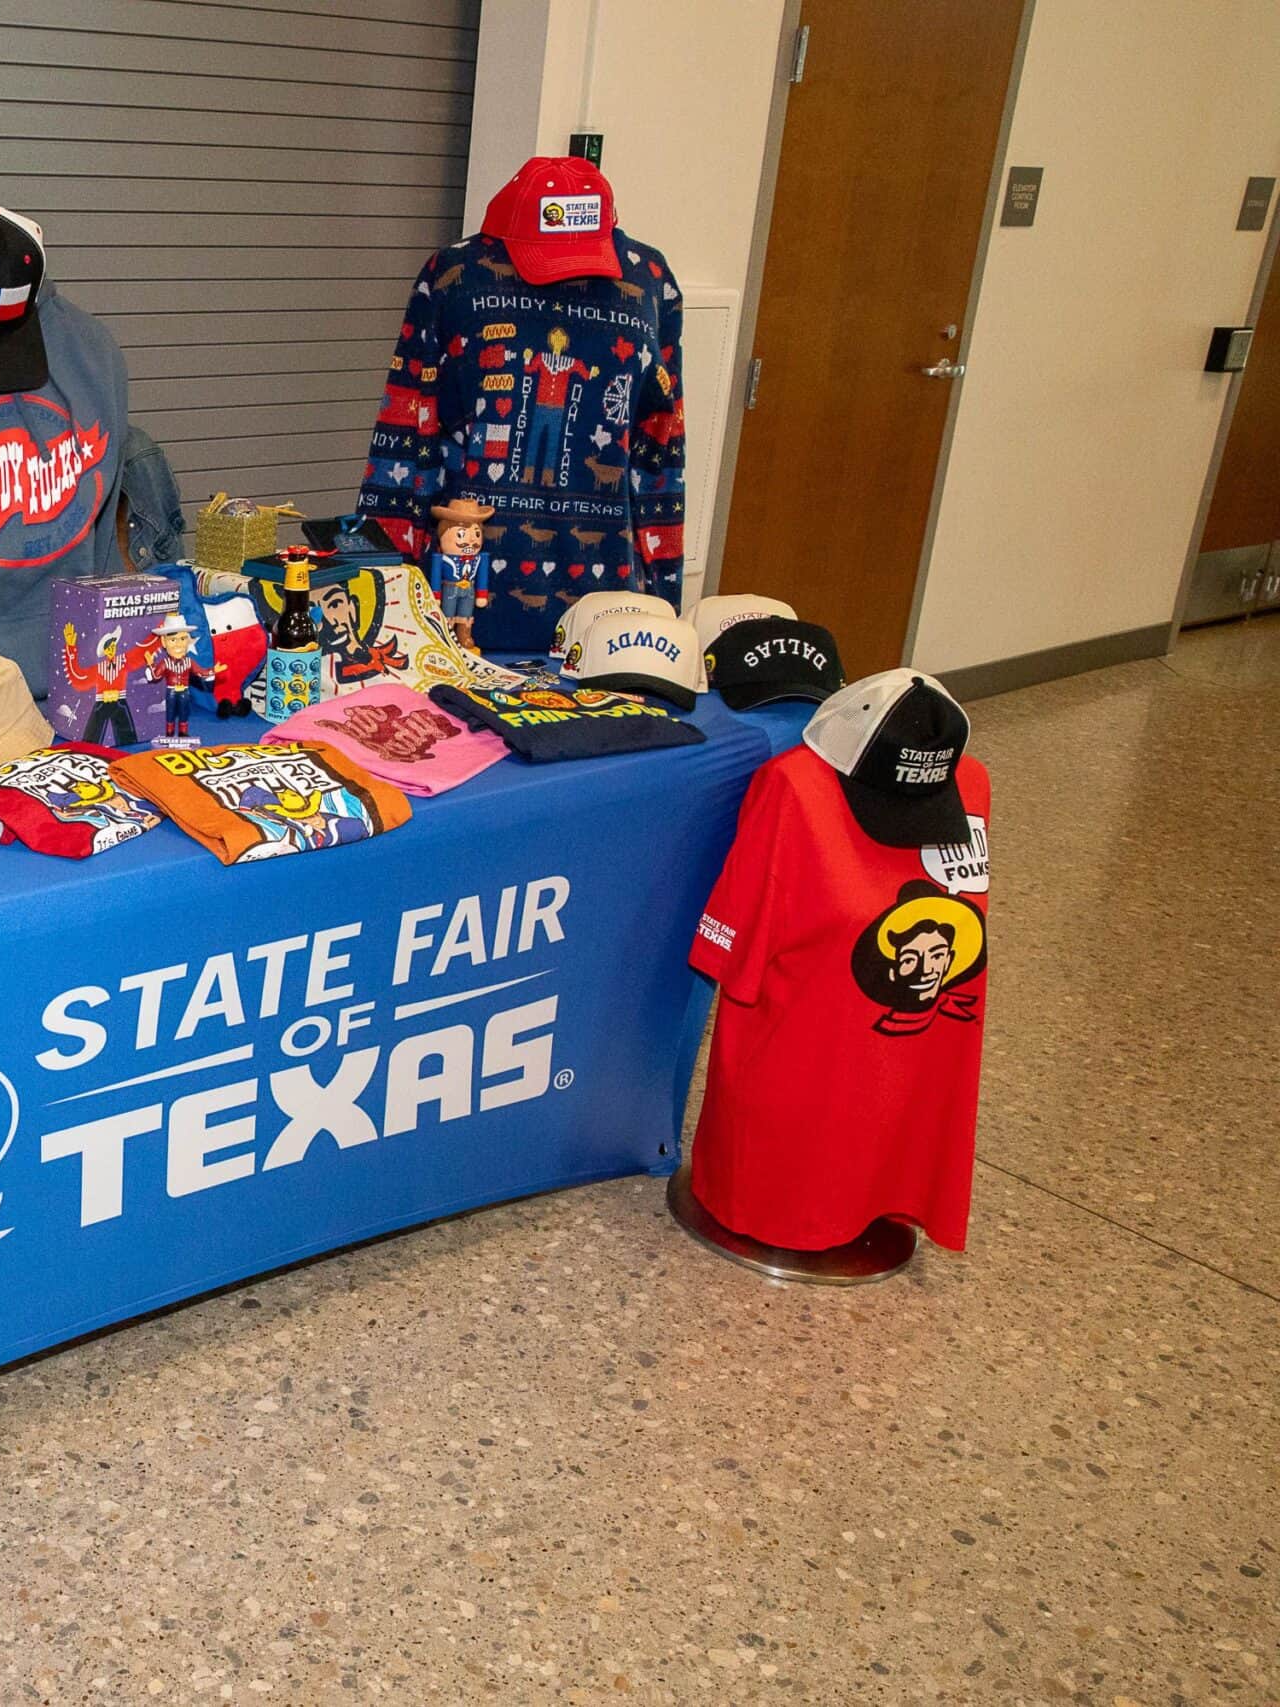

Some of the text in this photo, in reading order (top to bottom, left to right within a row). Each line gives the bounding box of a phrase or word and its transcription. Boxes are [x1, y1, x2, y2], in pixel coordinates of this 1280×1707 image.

[565, 215, 599, 226] TEXAS
[473, 296, 546, 312] HOWDY
[559, 384, 583, 487] DALLAS
[26, 436, 83, 515] FOLKS
[511, 497, 544, 510] FAIR
[550, 500, 570, 512] OF
[572, 500, 624, 516] TEXAS
[104, 594, 142, 608] TEXAS
[143, 590, 180, 604] SHINES
[103, 605, 146, 619] BRIGHT
[606, 630, 682, 664] HOWDY
[743, 637, 828, 671] DALLAS
[153, 746, 233, 776] BIG
[899, 747, 955, 762] STATE FAIR
[204, 764, 275, 786] OCTOBER
[895, 765, 949, 784] TEXAS
[699, 923, 733, 952] TEXAS
[35, 876, 570, 1071] STATE FAIR
[280, 1001, 375, 1057] OF
